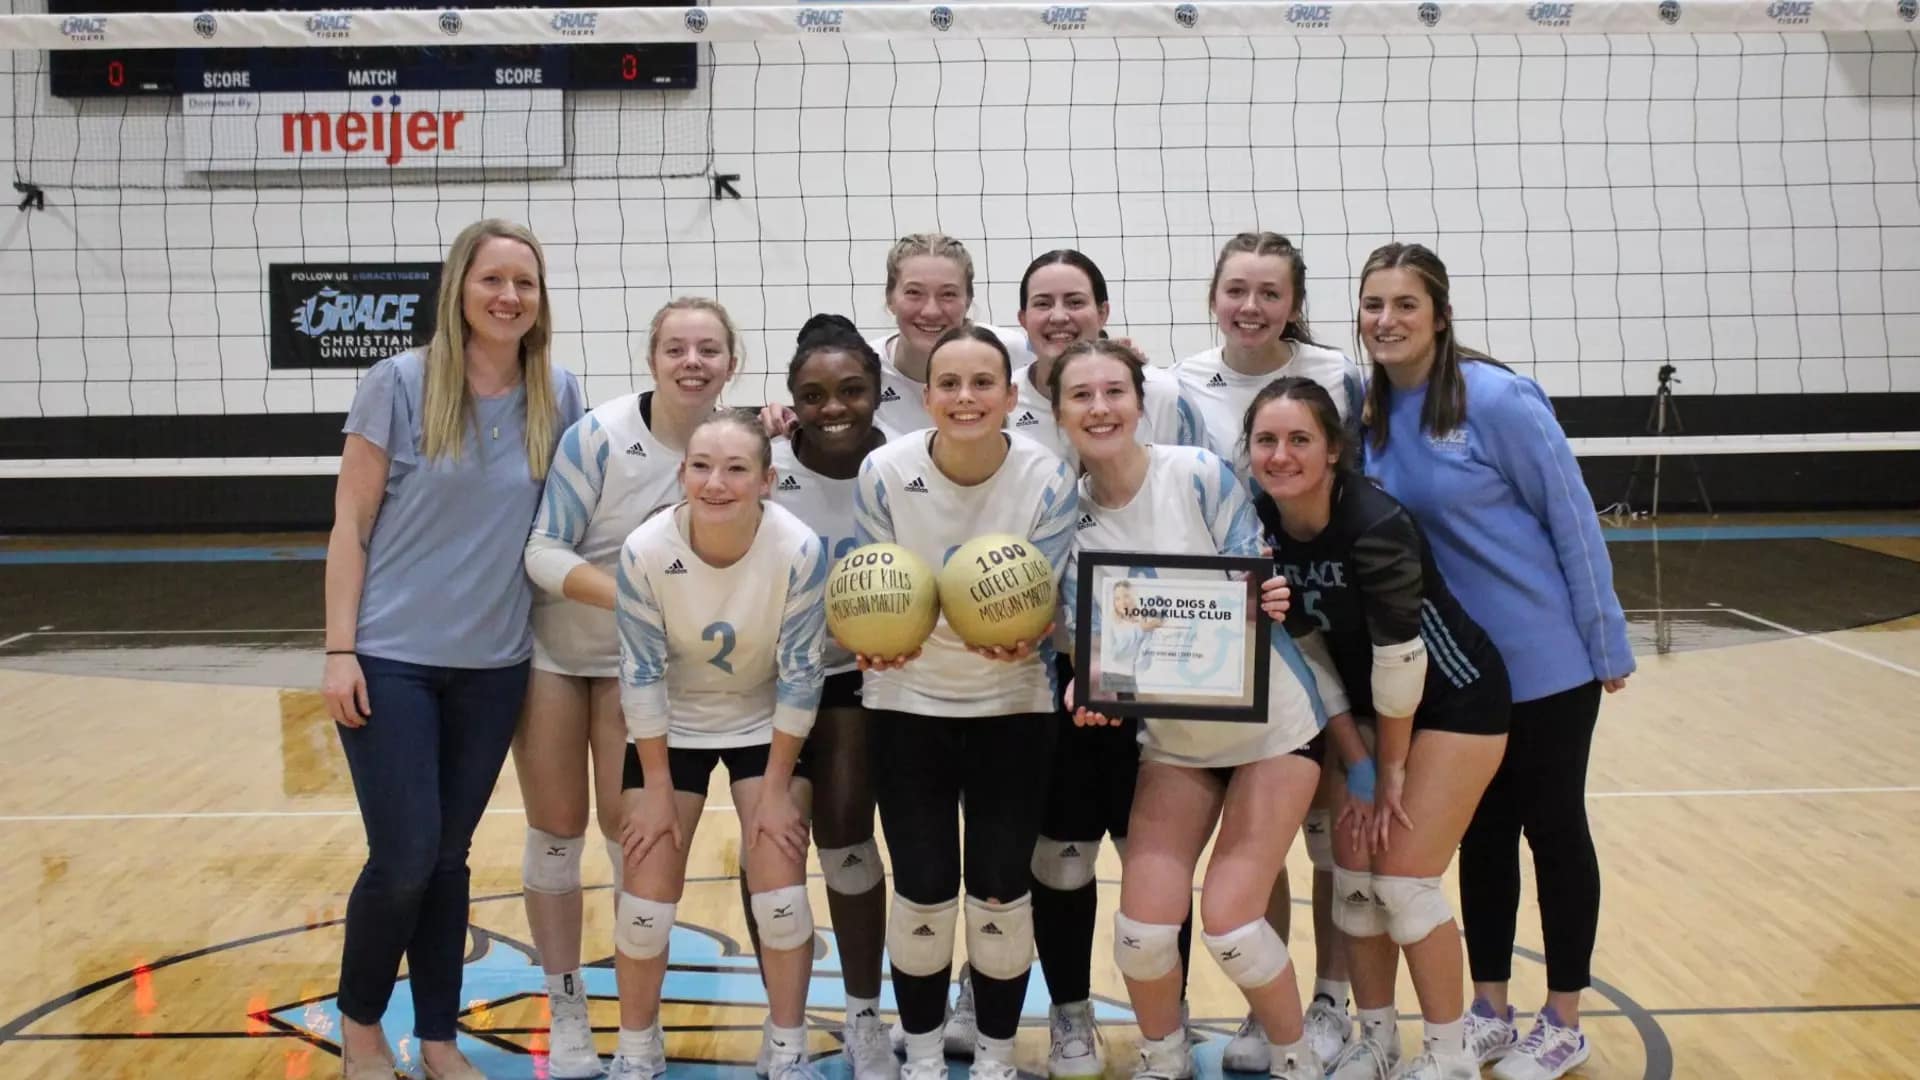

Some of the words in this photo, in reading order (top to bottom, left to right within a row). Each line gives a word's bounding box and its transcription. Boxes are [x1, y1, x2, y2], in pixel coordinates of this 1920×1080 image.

[305, 13, 353, 32] GRACE
[551, 11, 597, 30] GRACE
[796, 8, 844, 27] GRACE
[1041, 5, 1089, 25] GRACE
[1285, 4, 1333, 23] GRACE
[108, 61, 124, 87] 0
[495, 68, 542, 84] SCORE
[622, 54, 638, 80] 0
[203, 71, 250, 88] SCORE
[348, 70, 398, 86] MATCH
[282, 94, 465, 165] meijer
[291, 272, 333, 281] FOLLOW
[335, 272, 348, 280] US
[290, 286, 421, 337] GRACE
[320, 335, 413, 347] CHRISTIAN
[841, 552, 894, 573] 1000
[830, 569, 876, 598] career
[881, 568, 912, 591] KILLS
[969, 566, 1019, 602] career
[831, 596, 871, 624] MORGAN
[870, 592, 911, 614] MARTIN
[979, 594, 1024, 623] MORGAN
[1139, 597, 1173, 609] 1,000
[1176, 599, 1206, 609] DIGS
[1208, 599, 1217, 609] &
[1124, 607, 1158, 618] 1,000
[1160, 609, 1195, 619] KILLS
[1198, 610, 1232, 621] CLUB
[701, 621, 737, 675] 2
